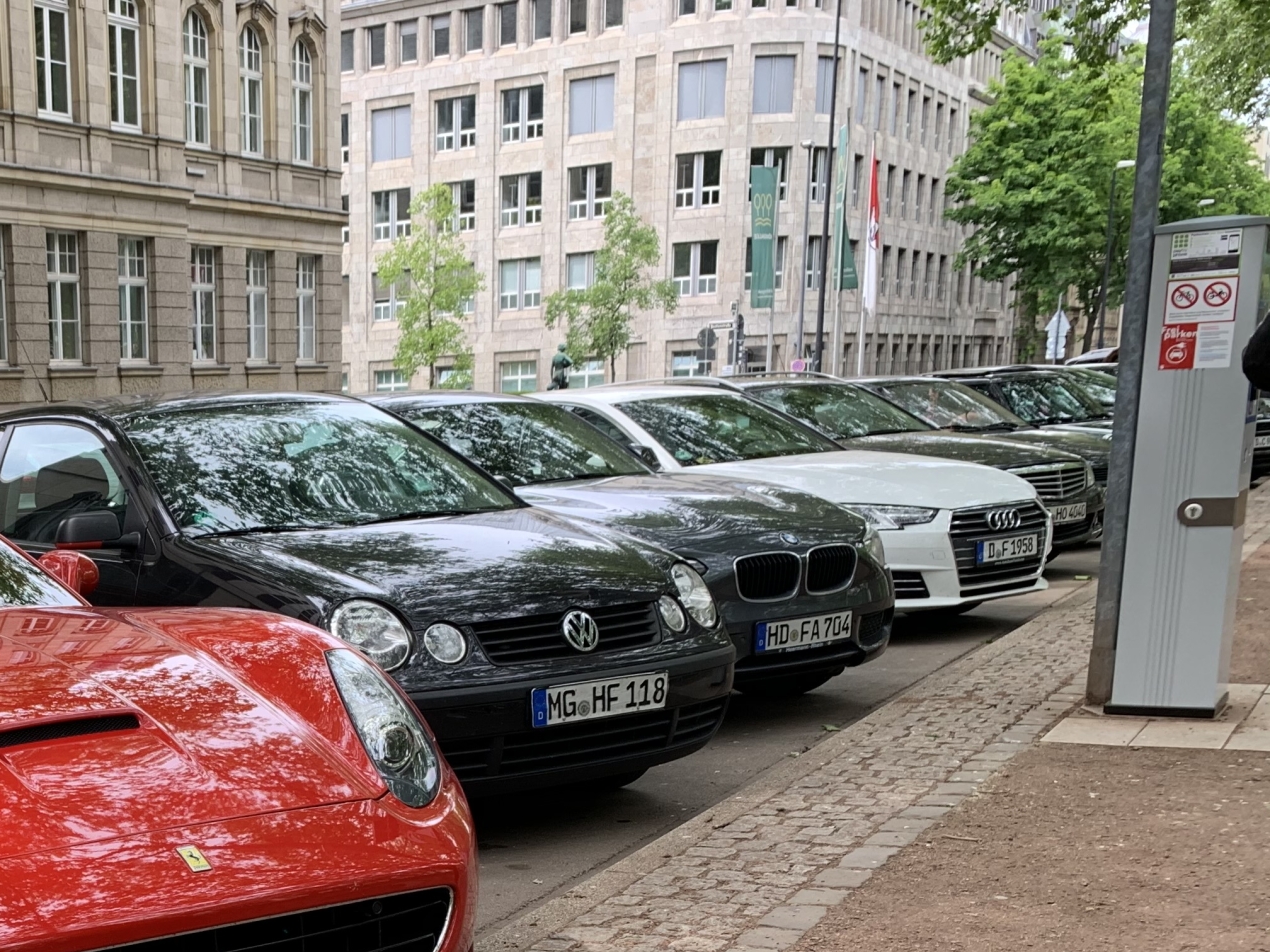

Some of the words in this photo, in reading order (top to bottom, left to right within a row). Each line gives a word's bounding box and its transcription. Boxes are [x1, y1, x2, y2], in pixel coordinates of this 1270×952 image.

[988, 542, 995, 559] D
[1002, 540, 1009, 557] F
[1010, 537, 1033, 556] 1958
[767, 623, 790, 647] HD
[799, 620, 820, 643] FA
[824, 614, 850, 639] 704
[537, 711, 544, 720] D
[548, 690, 577, 721] MG
[592, 683, 621, 714] HF
[625, 677, 665, 709] 118
